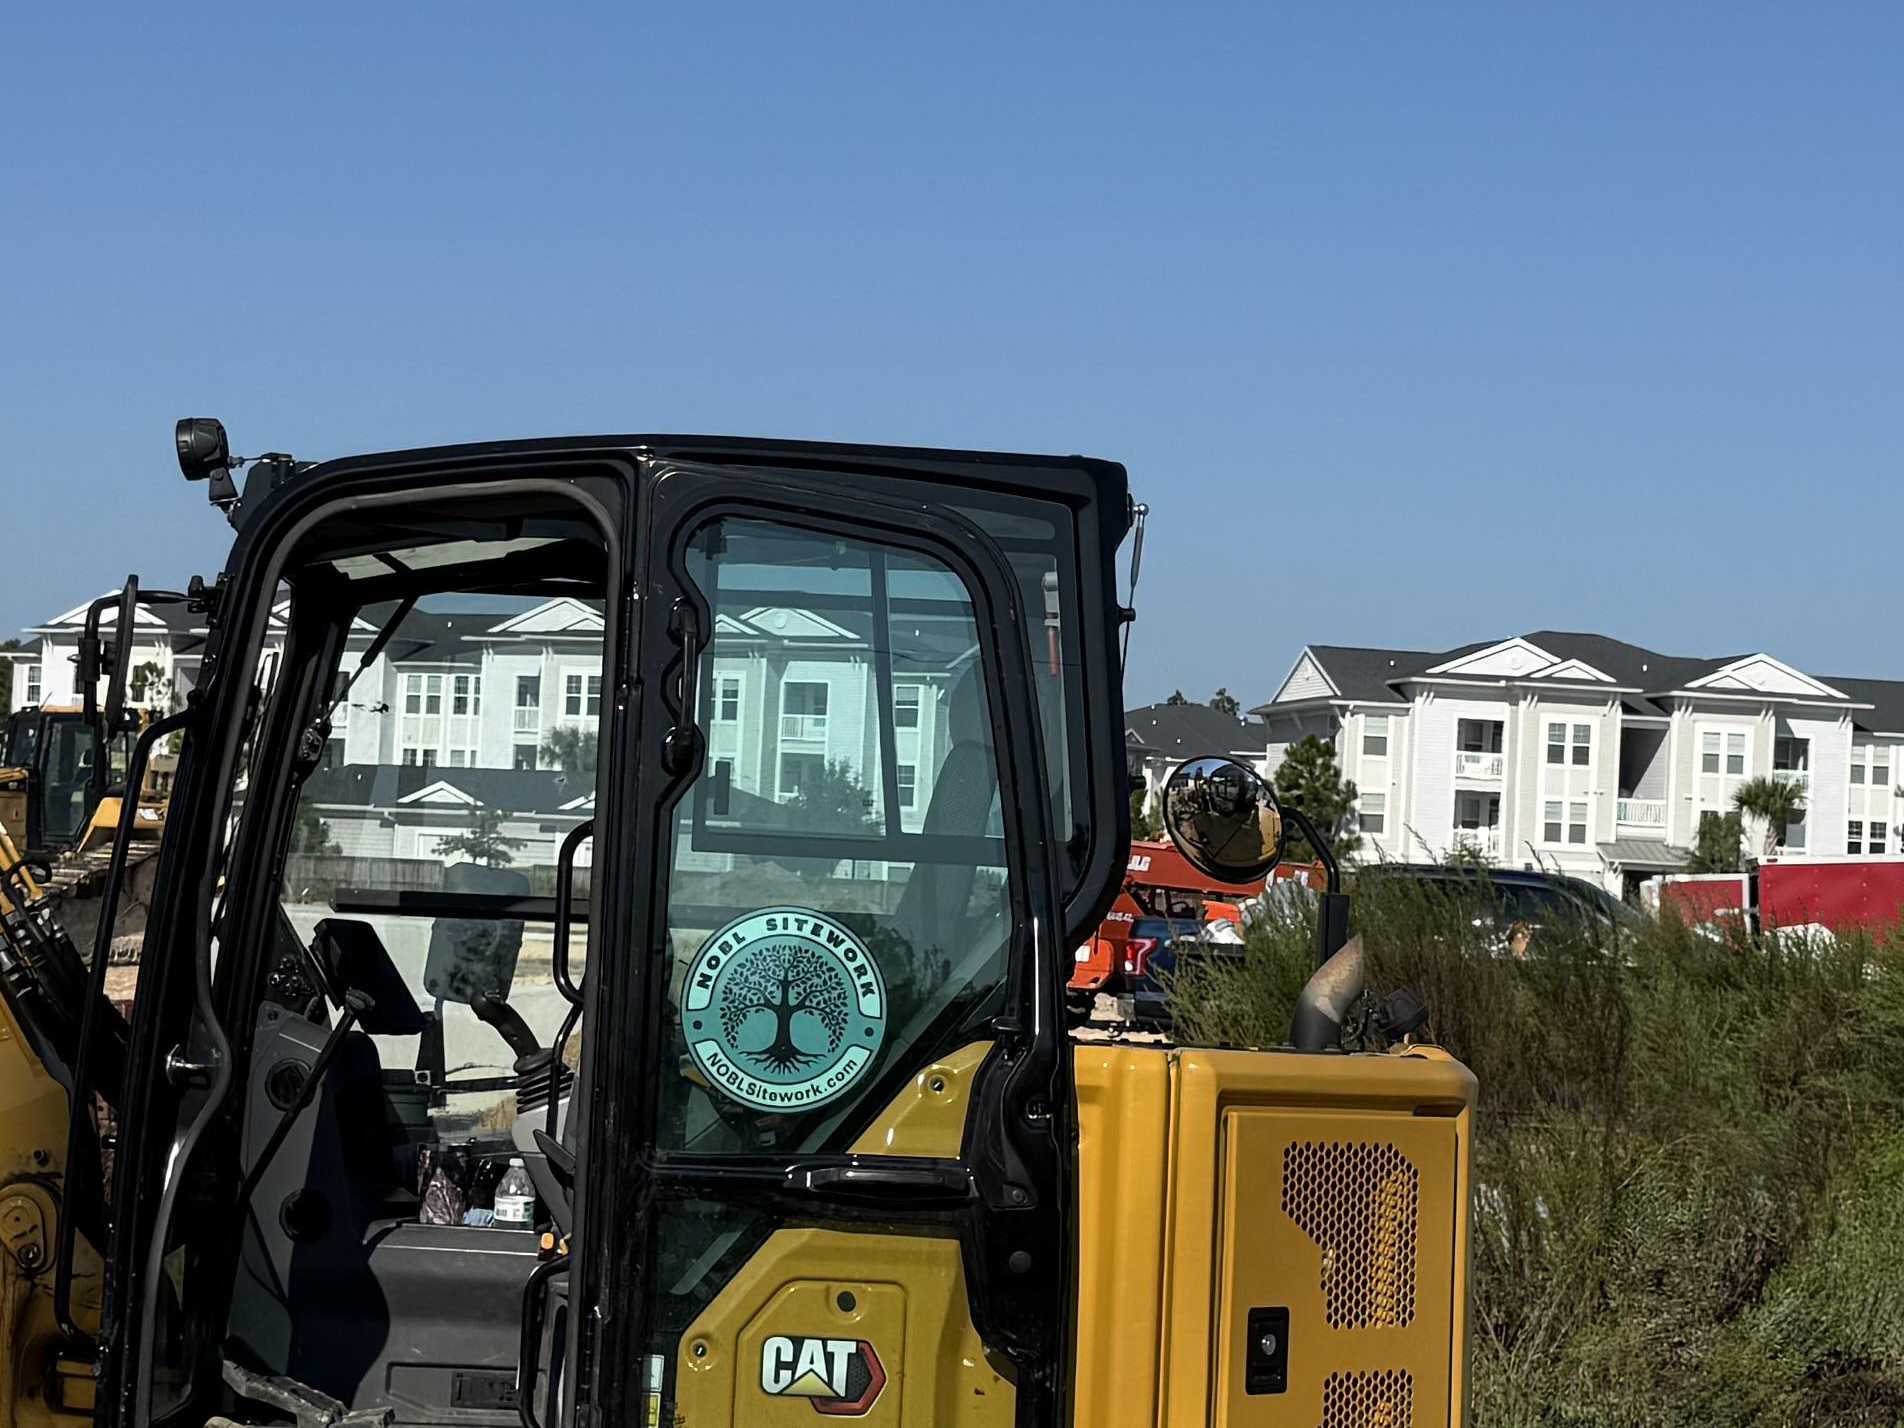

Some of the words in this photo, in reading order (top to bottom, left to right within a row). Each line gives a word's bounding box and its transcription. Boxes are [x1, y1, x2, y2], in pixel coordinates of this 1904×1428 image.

[696, 931, 746, 990] NOBL
[765, 917, 876, 998] SITEWORK
[707, 1052, 858, 1103] NOBLSitework.com
[762, 1336, 857, 1397] CAT
